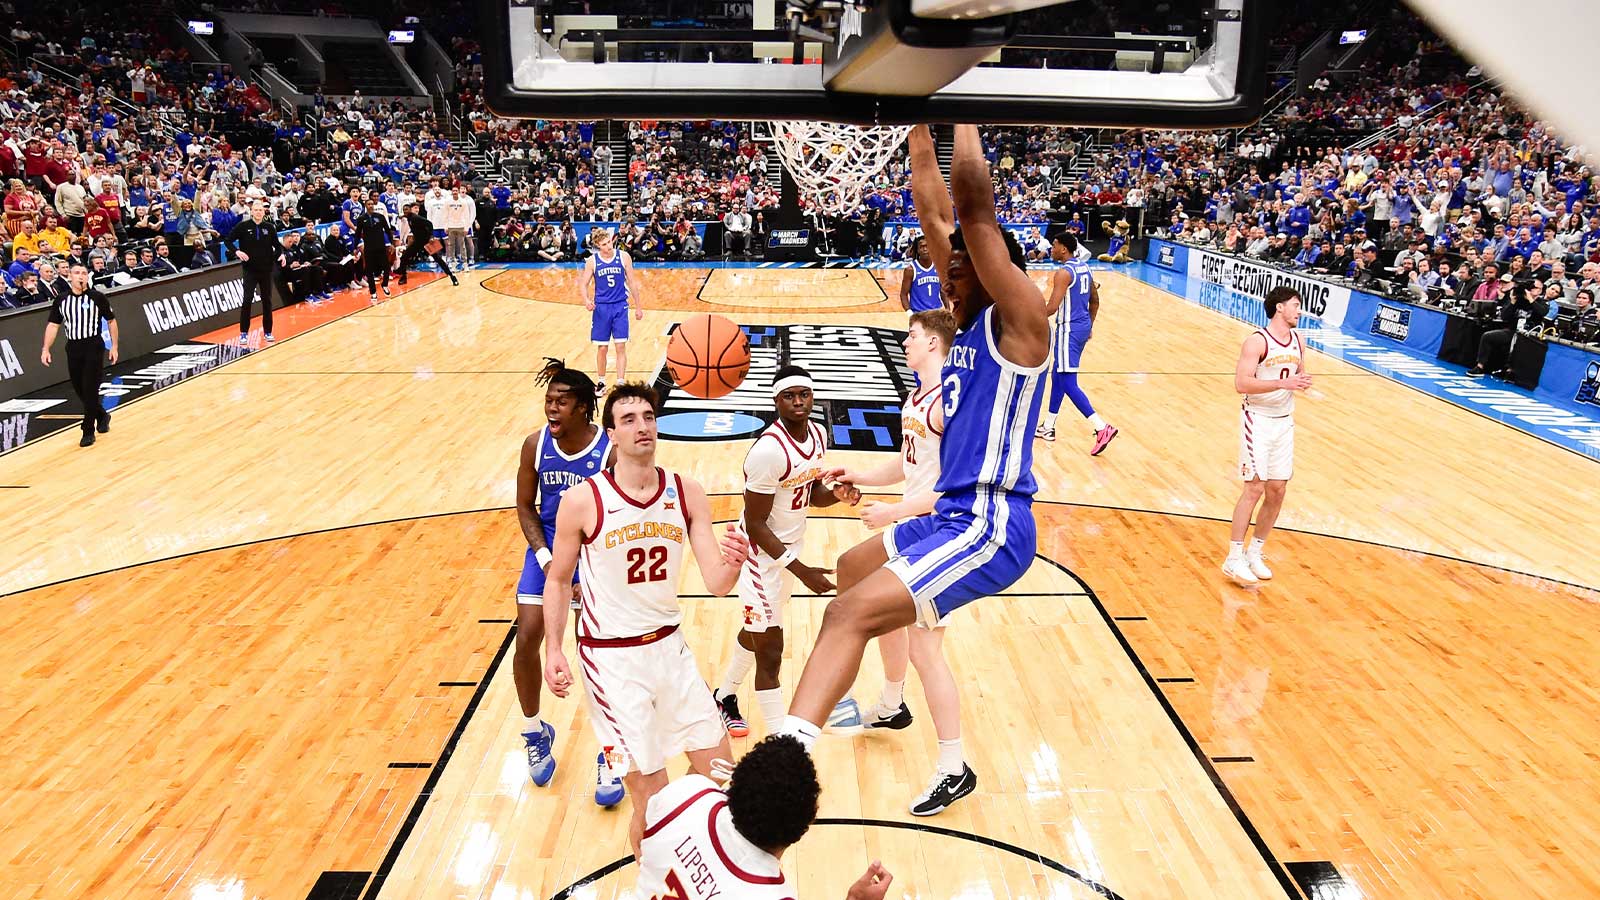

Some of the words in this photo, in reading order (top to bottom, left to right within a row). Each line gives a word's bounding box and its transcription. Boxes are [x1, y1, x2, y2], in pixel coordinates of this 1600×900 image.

[606, 274, 616, 288] 5
[1201, 254, 1225, 284] FIRST
[1232, 262, 1273, 298] SECOND
[927, 283, 932, 297] 1
[1379, 306, 1401, 323] MARCH
[1379, 318, 1409, 337] MADNESS
[943, 345, 977, 370] UCKY
[605, 521, 684, 549] CYCLONES
[626, 545, 668, 585] 22
[674, 835, 722, 900] LIPSEY
